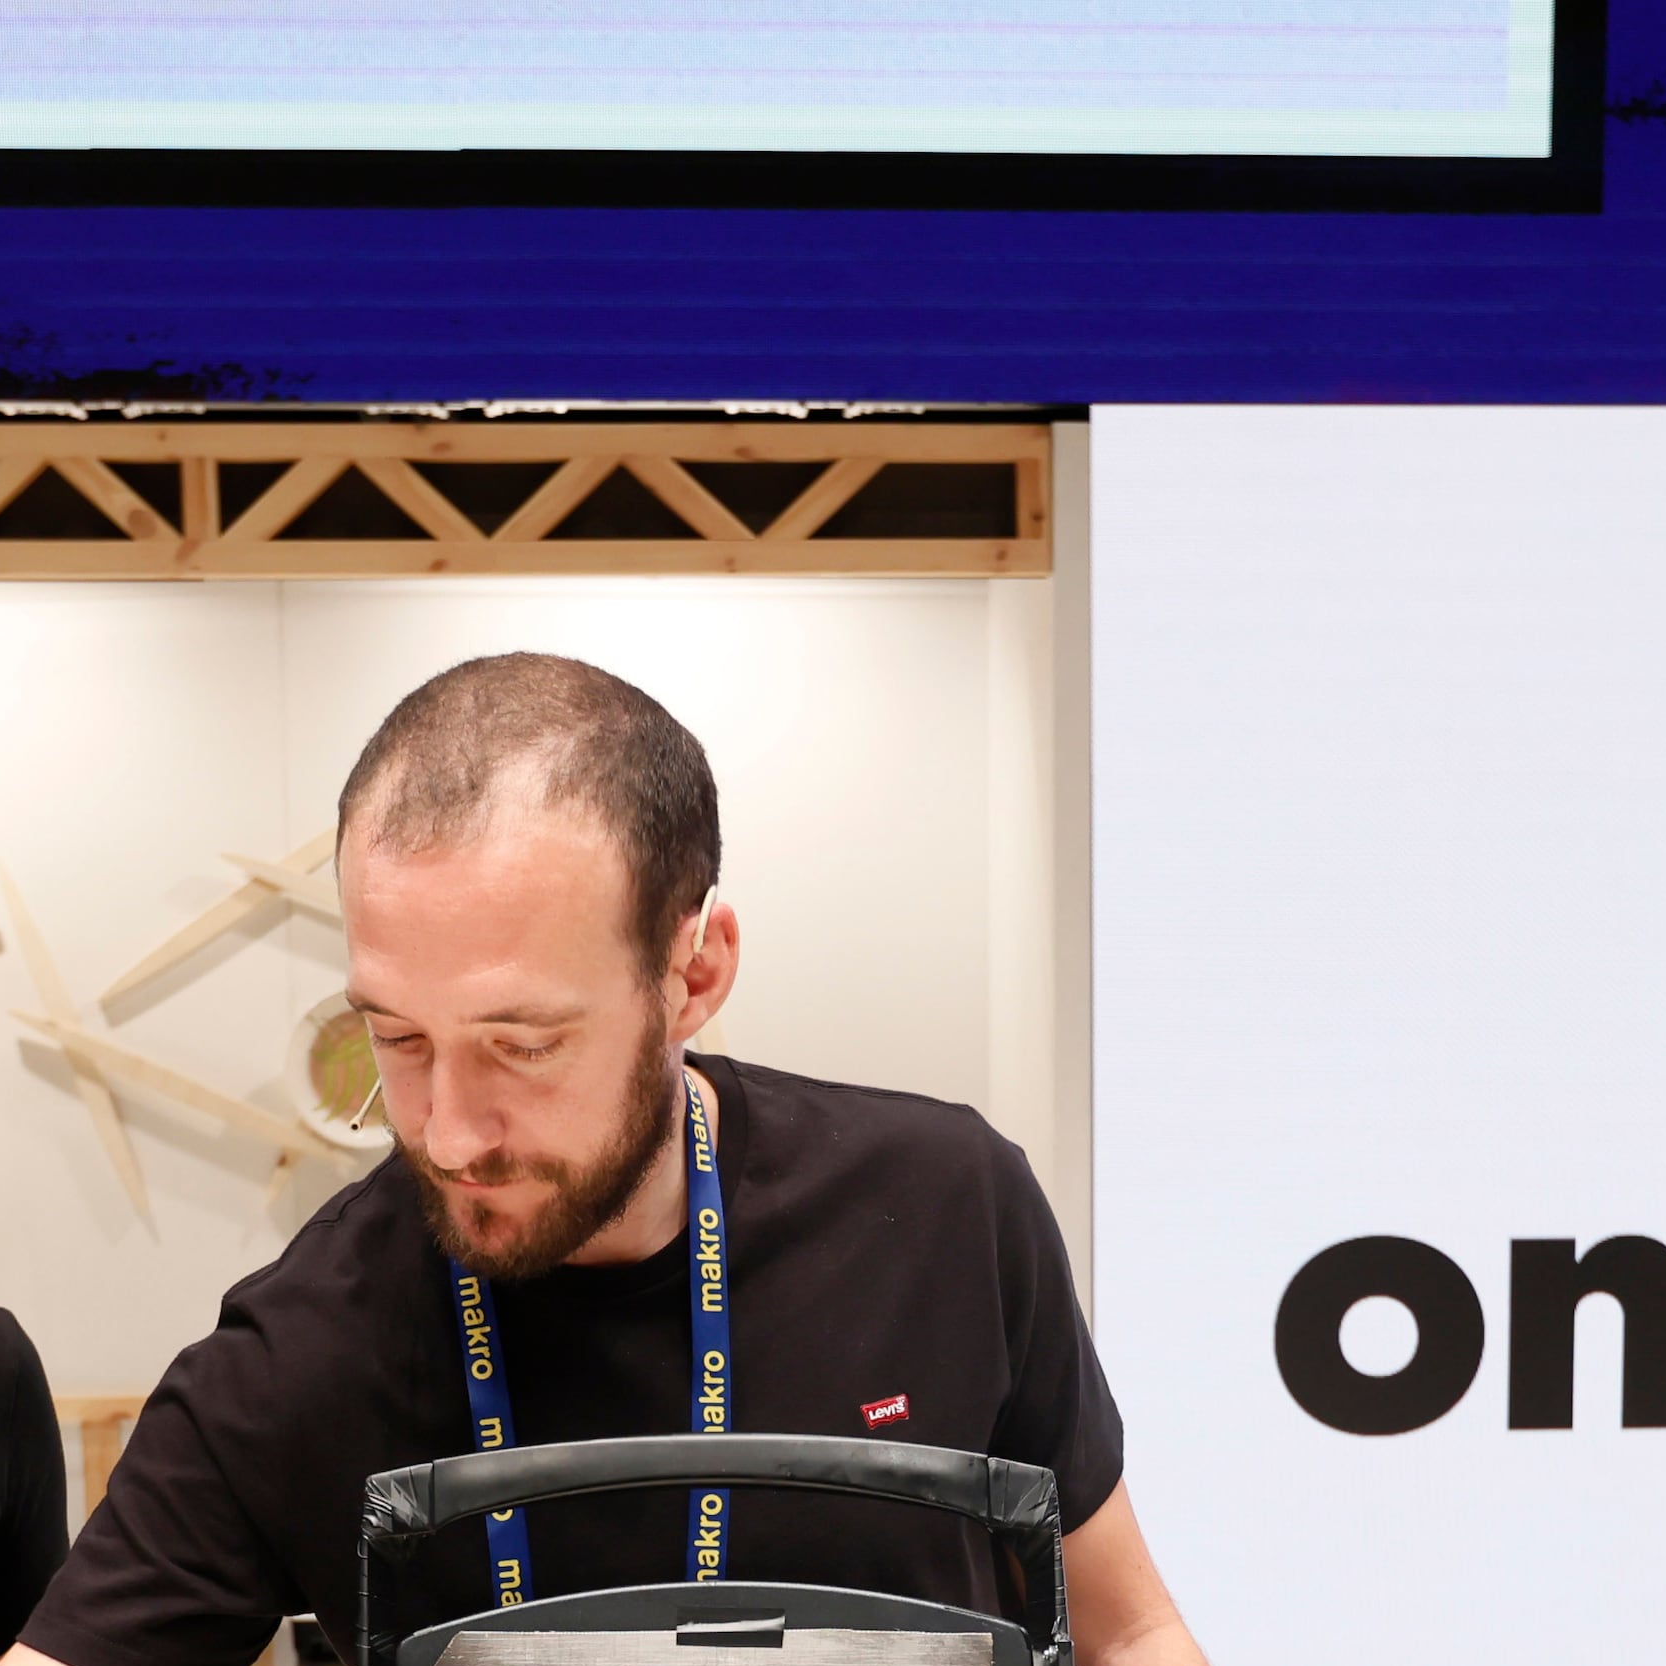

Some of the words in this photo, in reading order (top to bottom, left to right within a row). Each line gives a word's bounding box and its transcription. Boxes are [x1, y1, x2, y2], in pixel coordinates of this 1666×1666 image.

[684, 1072, 713, 1172] makro
[696, 1208, 723, 1312] makro
[459, 1277, 493, 1380] makro
[698, 1350, 725, 1433] akro
